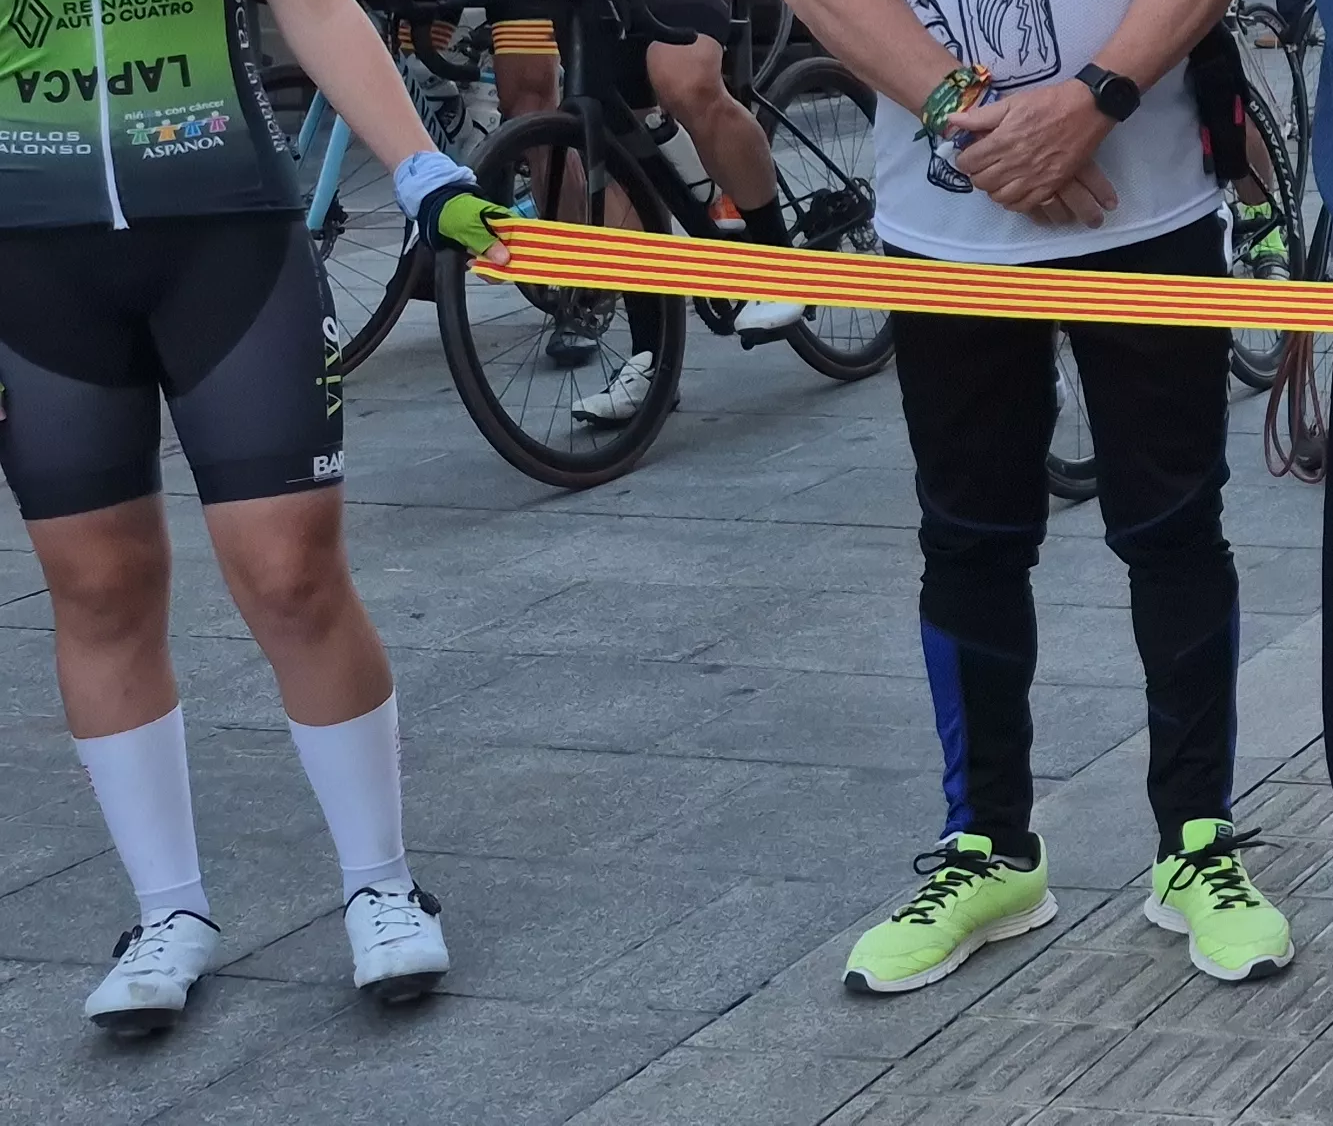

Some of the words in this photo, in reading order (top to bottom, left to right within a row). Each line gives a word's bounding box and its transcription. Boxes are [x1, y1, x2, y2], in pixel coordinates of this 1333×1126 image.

[55, 12, 117, 31] AUTO
[119, 0, 194, 22] CUATRO
[14, 53, 192, 104] LAPACA
[164, 107, 187, 117] con
[189, 99, 225, 112] cáncer
[142, 136, 225, 160] ASPANOA
